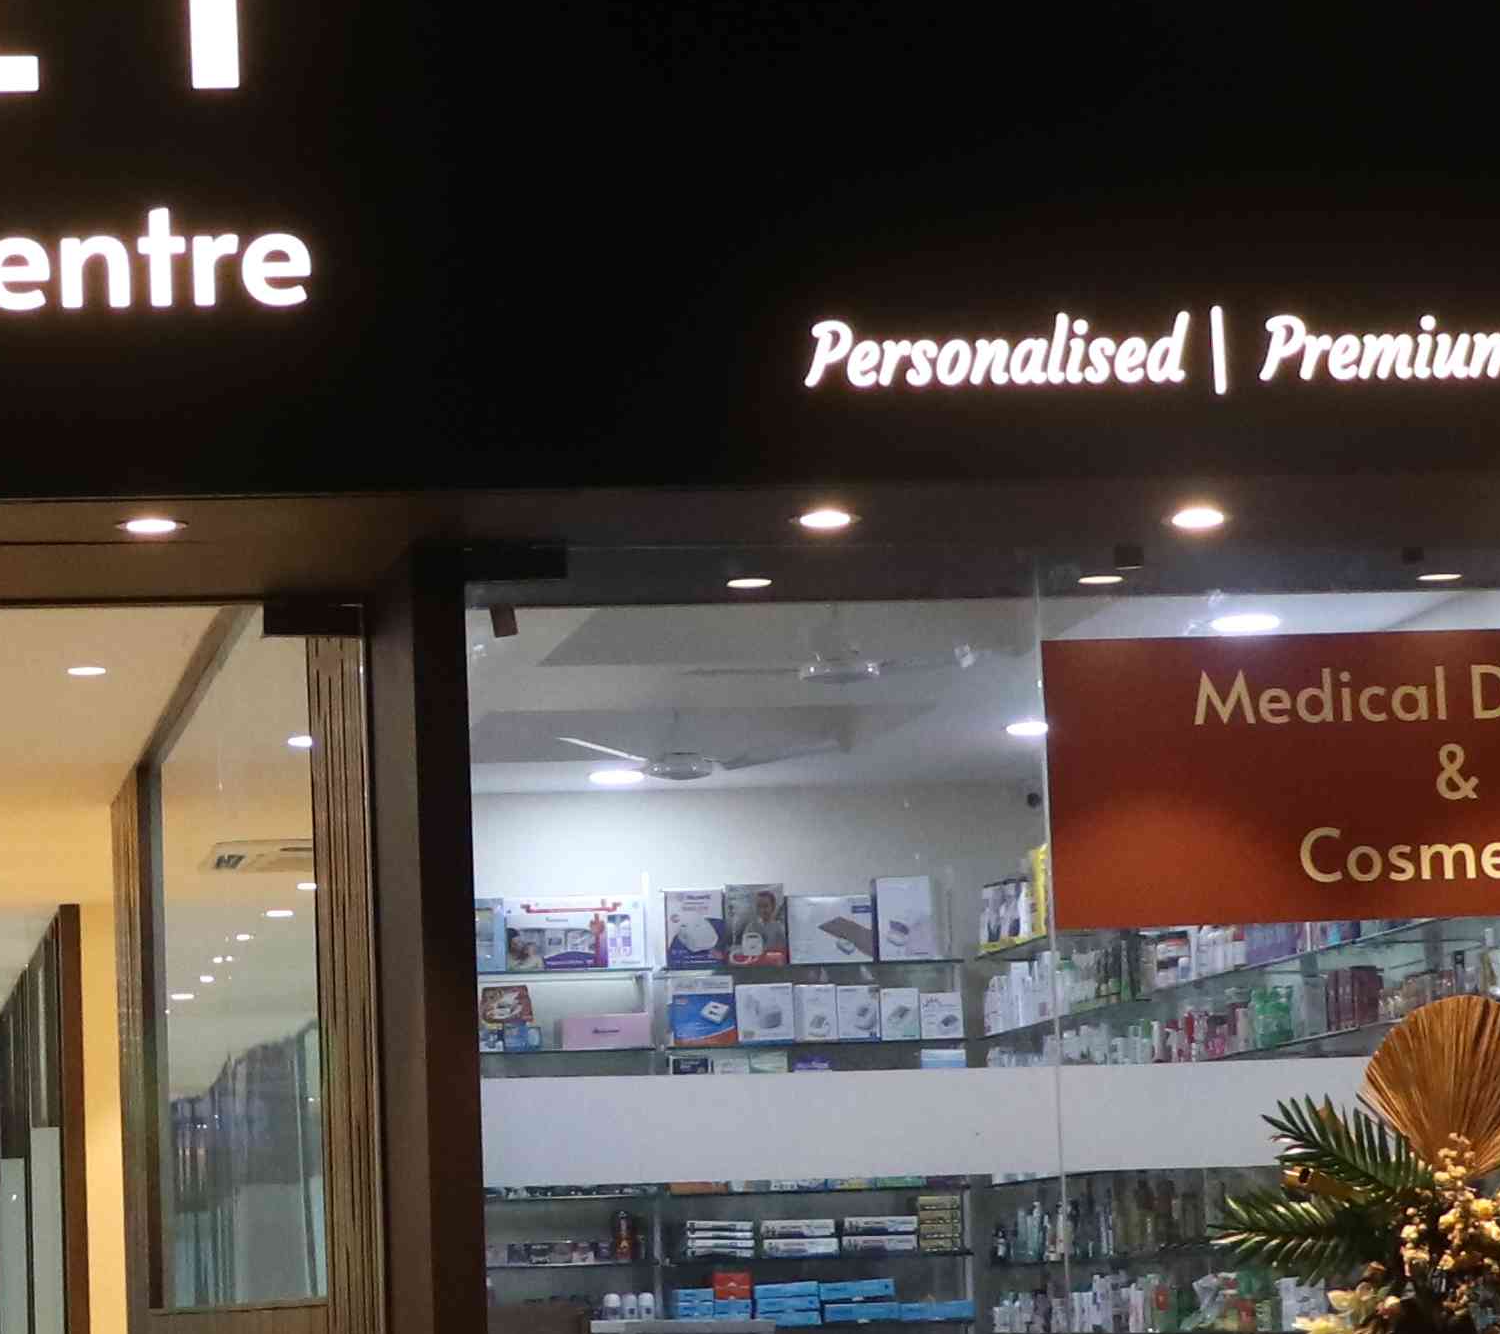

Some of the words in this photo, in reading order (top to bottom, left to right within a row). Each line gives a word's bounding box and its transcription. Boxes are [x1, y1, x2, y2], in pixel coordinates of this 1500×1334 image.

[804, 310, 1191, 388] Personalised
[1193, 665, 1448, 727] Medical
[1436, 743, 1479, 801] &
